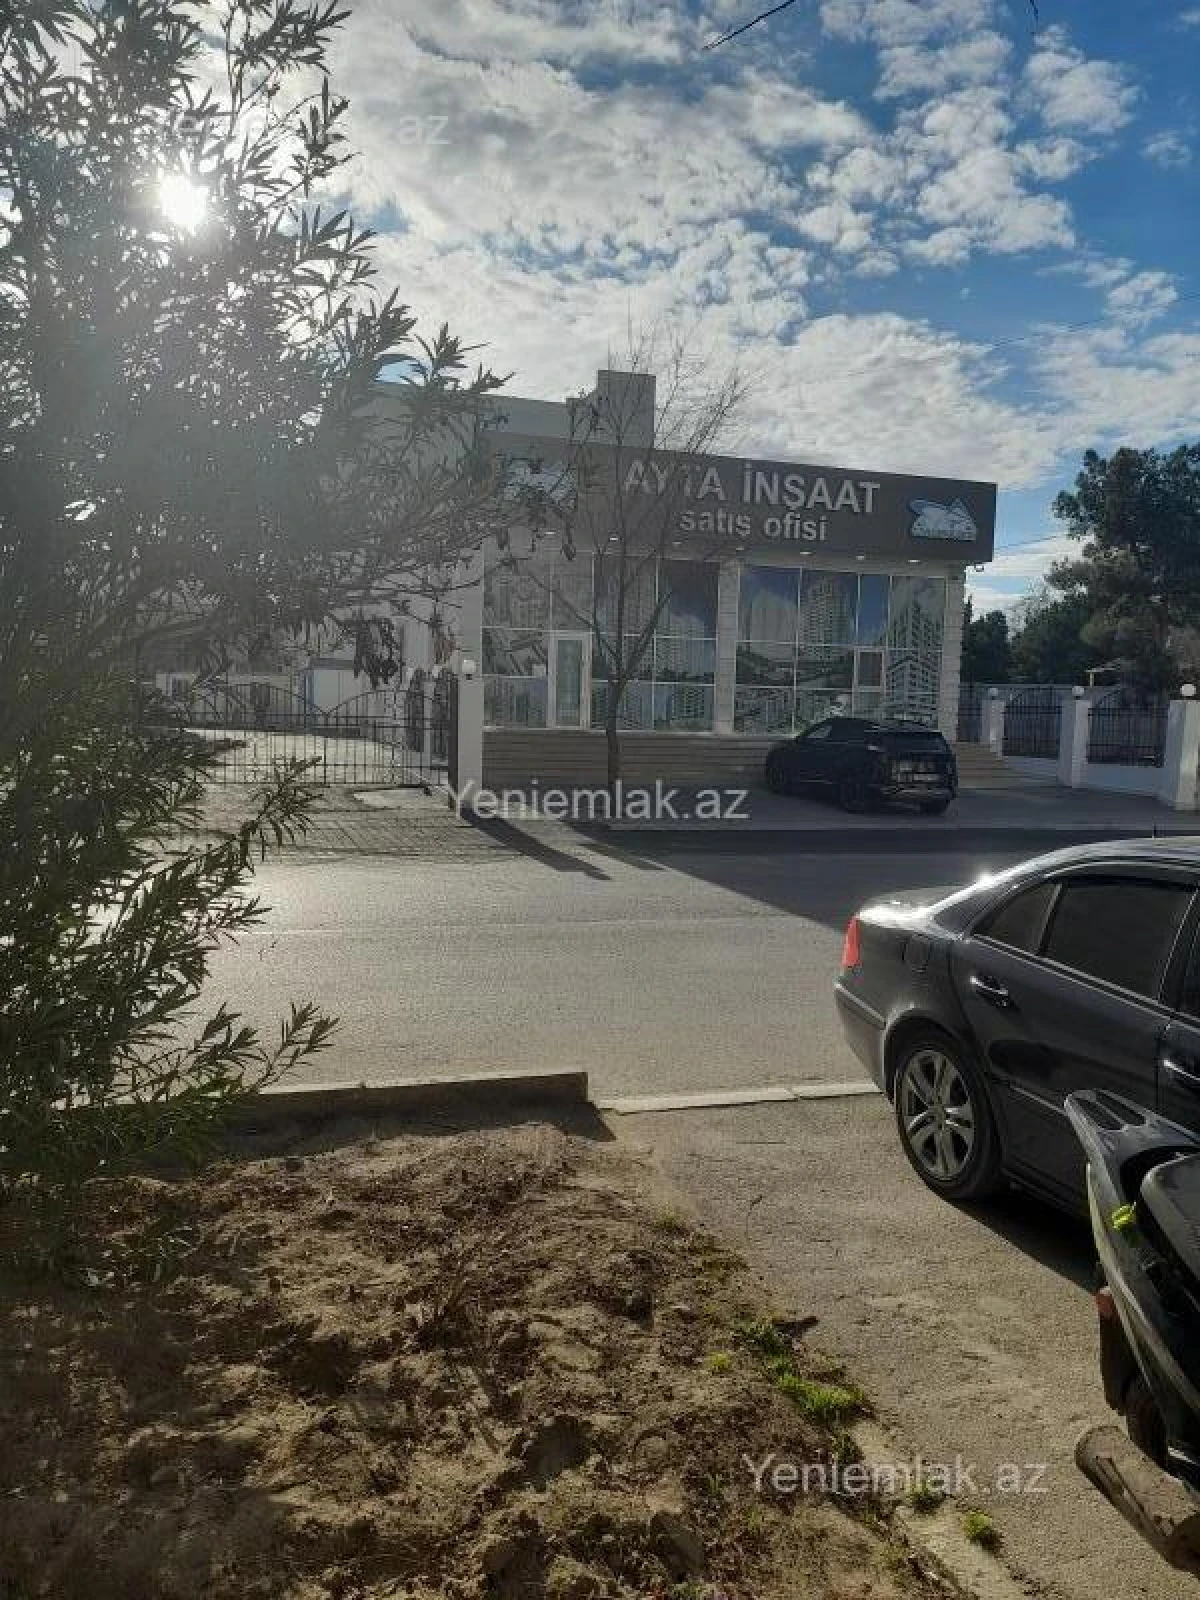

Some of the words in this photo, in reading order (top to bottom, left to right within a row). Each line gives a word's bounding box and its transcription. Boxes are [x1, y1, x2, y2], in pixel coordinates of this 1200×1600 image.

[743, 463, 880, 513] İNŞAAT
[679, 507, 751, 537] satış
[763, 511, 828, 541] ofisi
